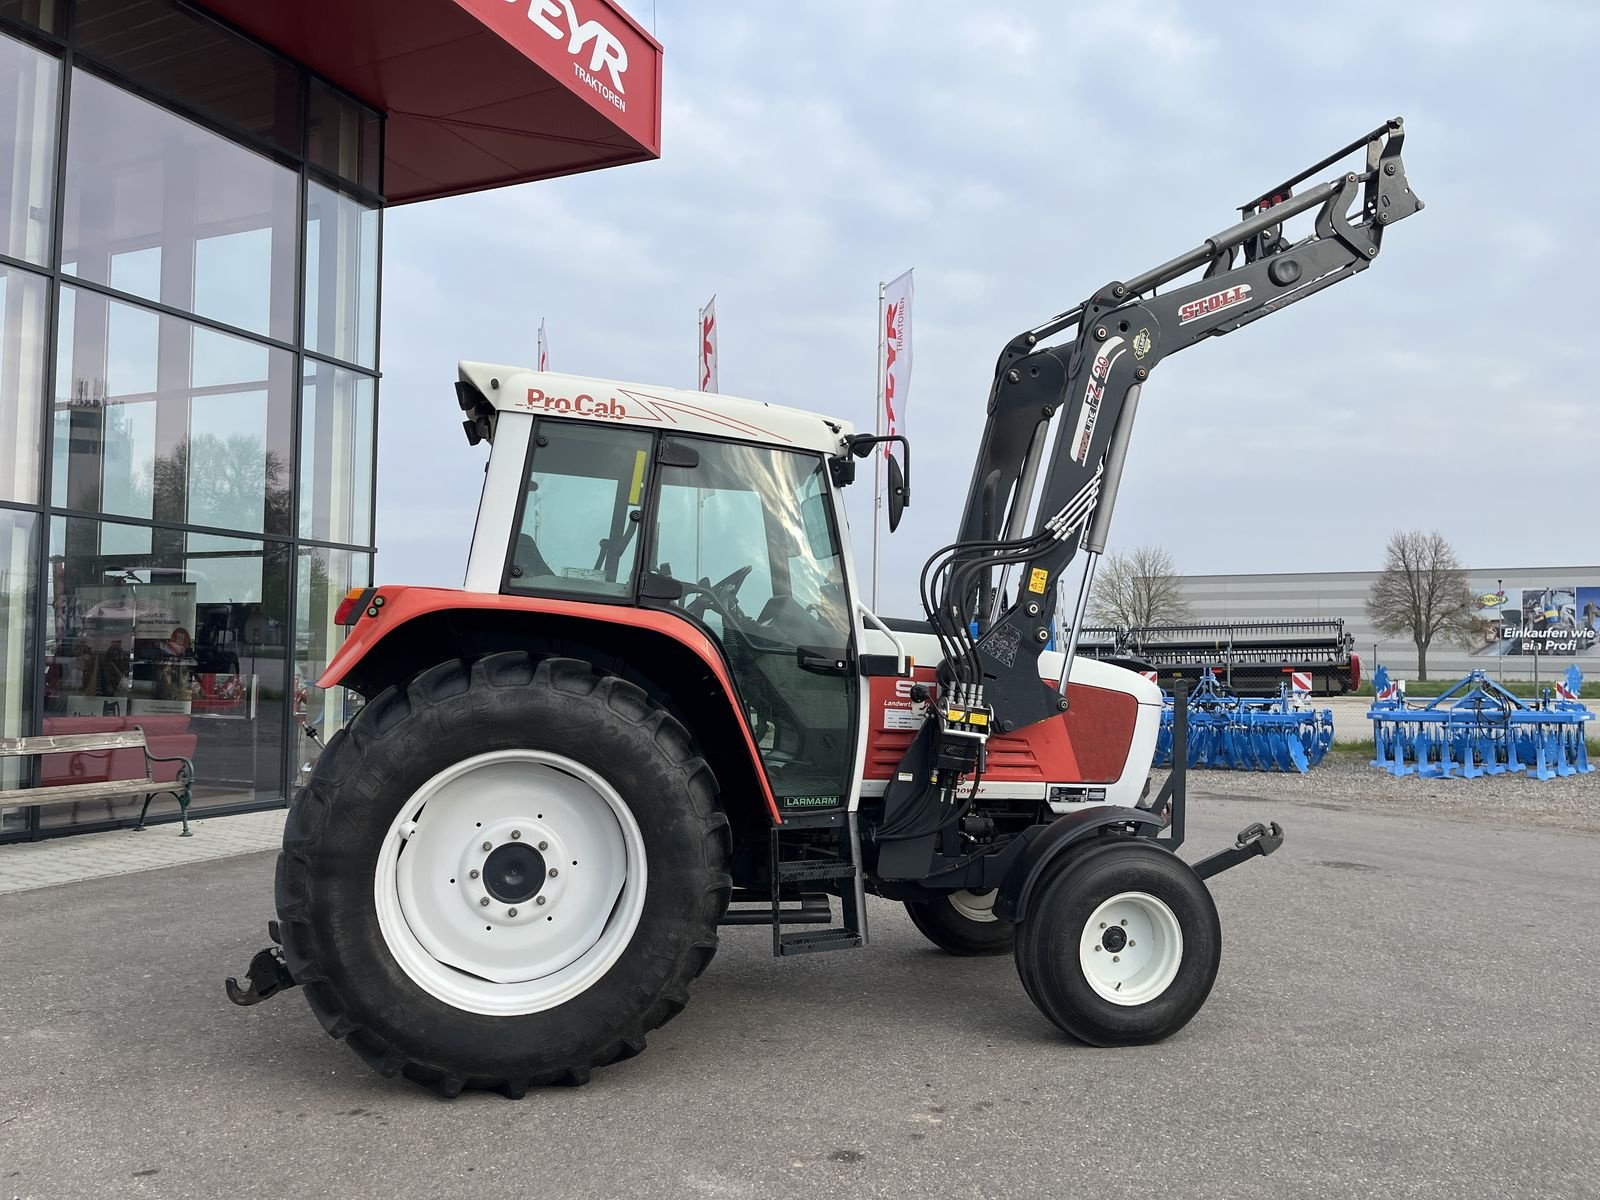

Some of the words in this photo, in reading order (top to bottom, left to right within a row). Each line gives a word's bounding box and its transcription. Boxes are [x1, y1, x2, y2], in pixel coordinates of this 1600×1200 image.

[504, 0, 628, 94] EYR
[573, 62, 626, 112] TRAKTOREN
[1181, 287, 1246, 321] STOLL
[896, 297, 905, 352] TRAKTOREN
[1094, 356, 1109, 379] 20
[1503, 627, 1568, 638] Einkaufen
[1571, 627, 1595, 638] wie
[1522, 639, 1541, 651] ein
[1545, 640, 1577, 651] Profi
